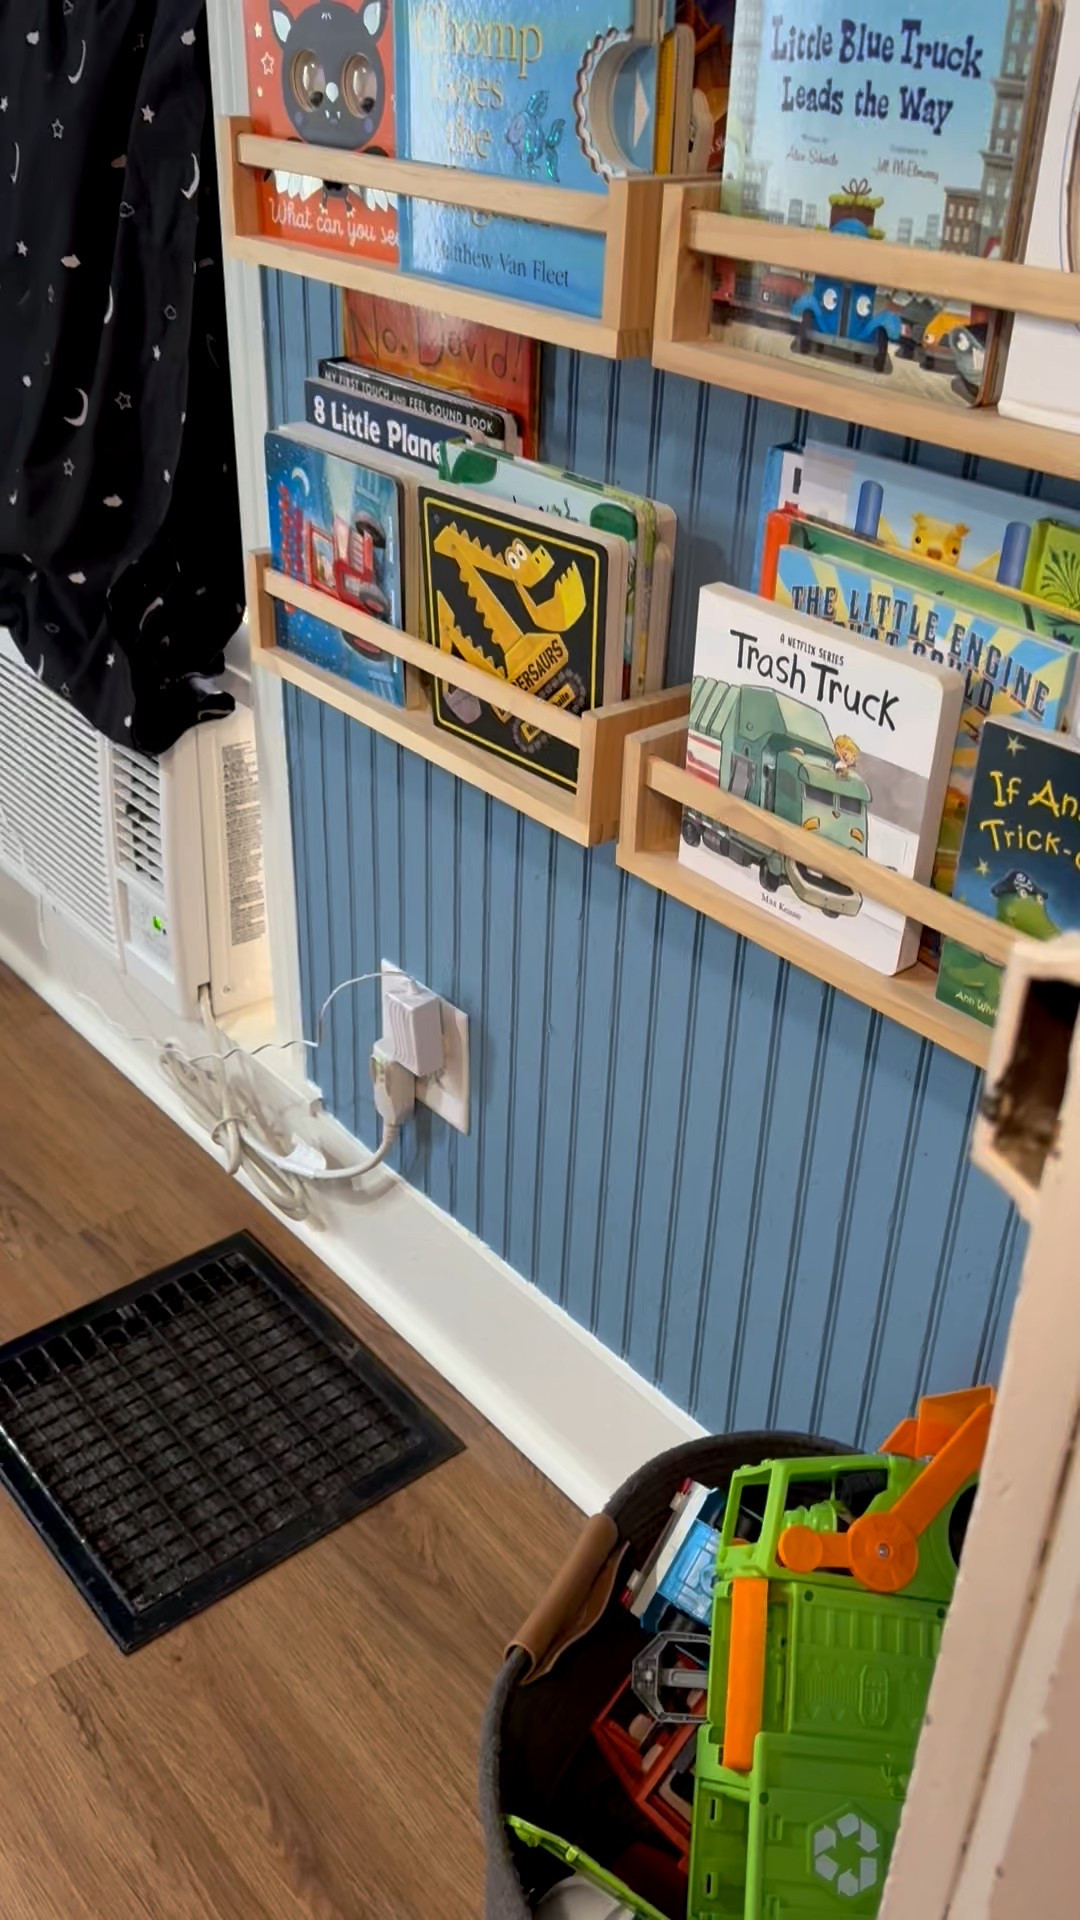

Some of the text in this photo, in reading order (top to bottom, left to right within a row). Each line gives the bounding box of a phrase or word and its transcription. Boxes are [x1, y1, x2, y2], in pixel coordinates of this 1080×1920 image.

[771, 15, 984, 79] Little Blue Truck
[781, 76, 954, 136] Leads the Way
[268, 197, 314, 229] What
[316, 216, 344, 236] can
[347, 221, 376, 248] you
[432, 238, 569, 288] Matthew Van Fleet
[314, 395, 326, 425] 8
[330, 401, 381, 443] Little
[324, 371, 336, 383] MY
[339, 374, 359, 389] FIRST
[361, 380, 390, 401] TOUCH
[409, 396, 428, 413] FEEL
[430, 402, 463, 424] SOUND
[466, 413, 493, 434] BOOK
[511, 638, 564, 692] ERSAURS
[780, 633, 844, 666] A NETFLIX SERIES
[792, 586, 837, 622] THE
[850, 589, 939, 650] LITTLE
[950, 622, 1050, 722] ENGINE
[730, 629, 806, 694] Trash
[811, 661, 900, 731] Truck
[989, 770, 1080, 821] If An
[955, 990, 975, 1006] Ann
